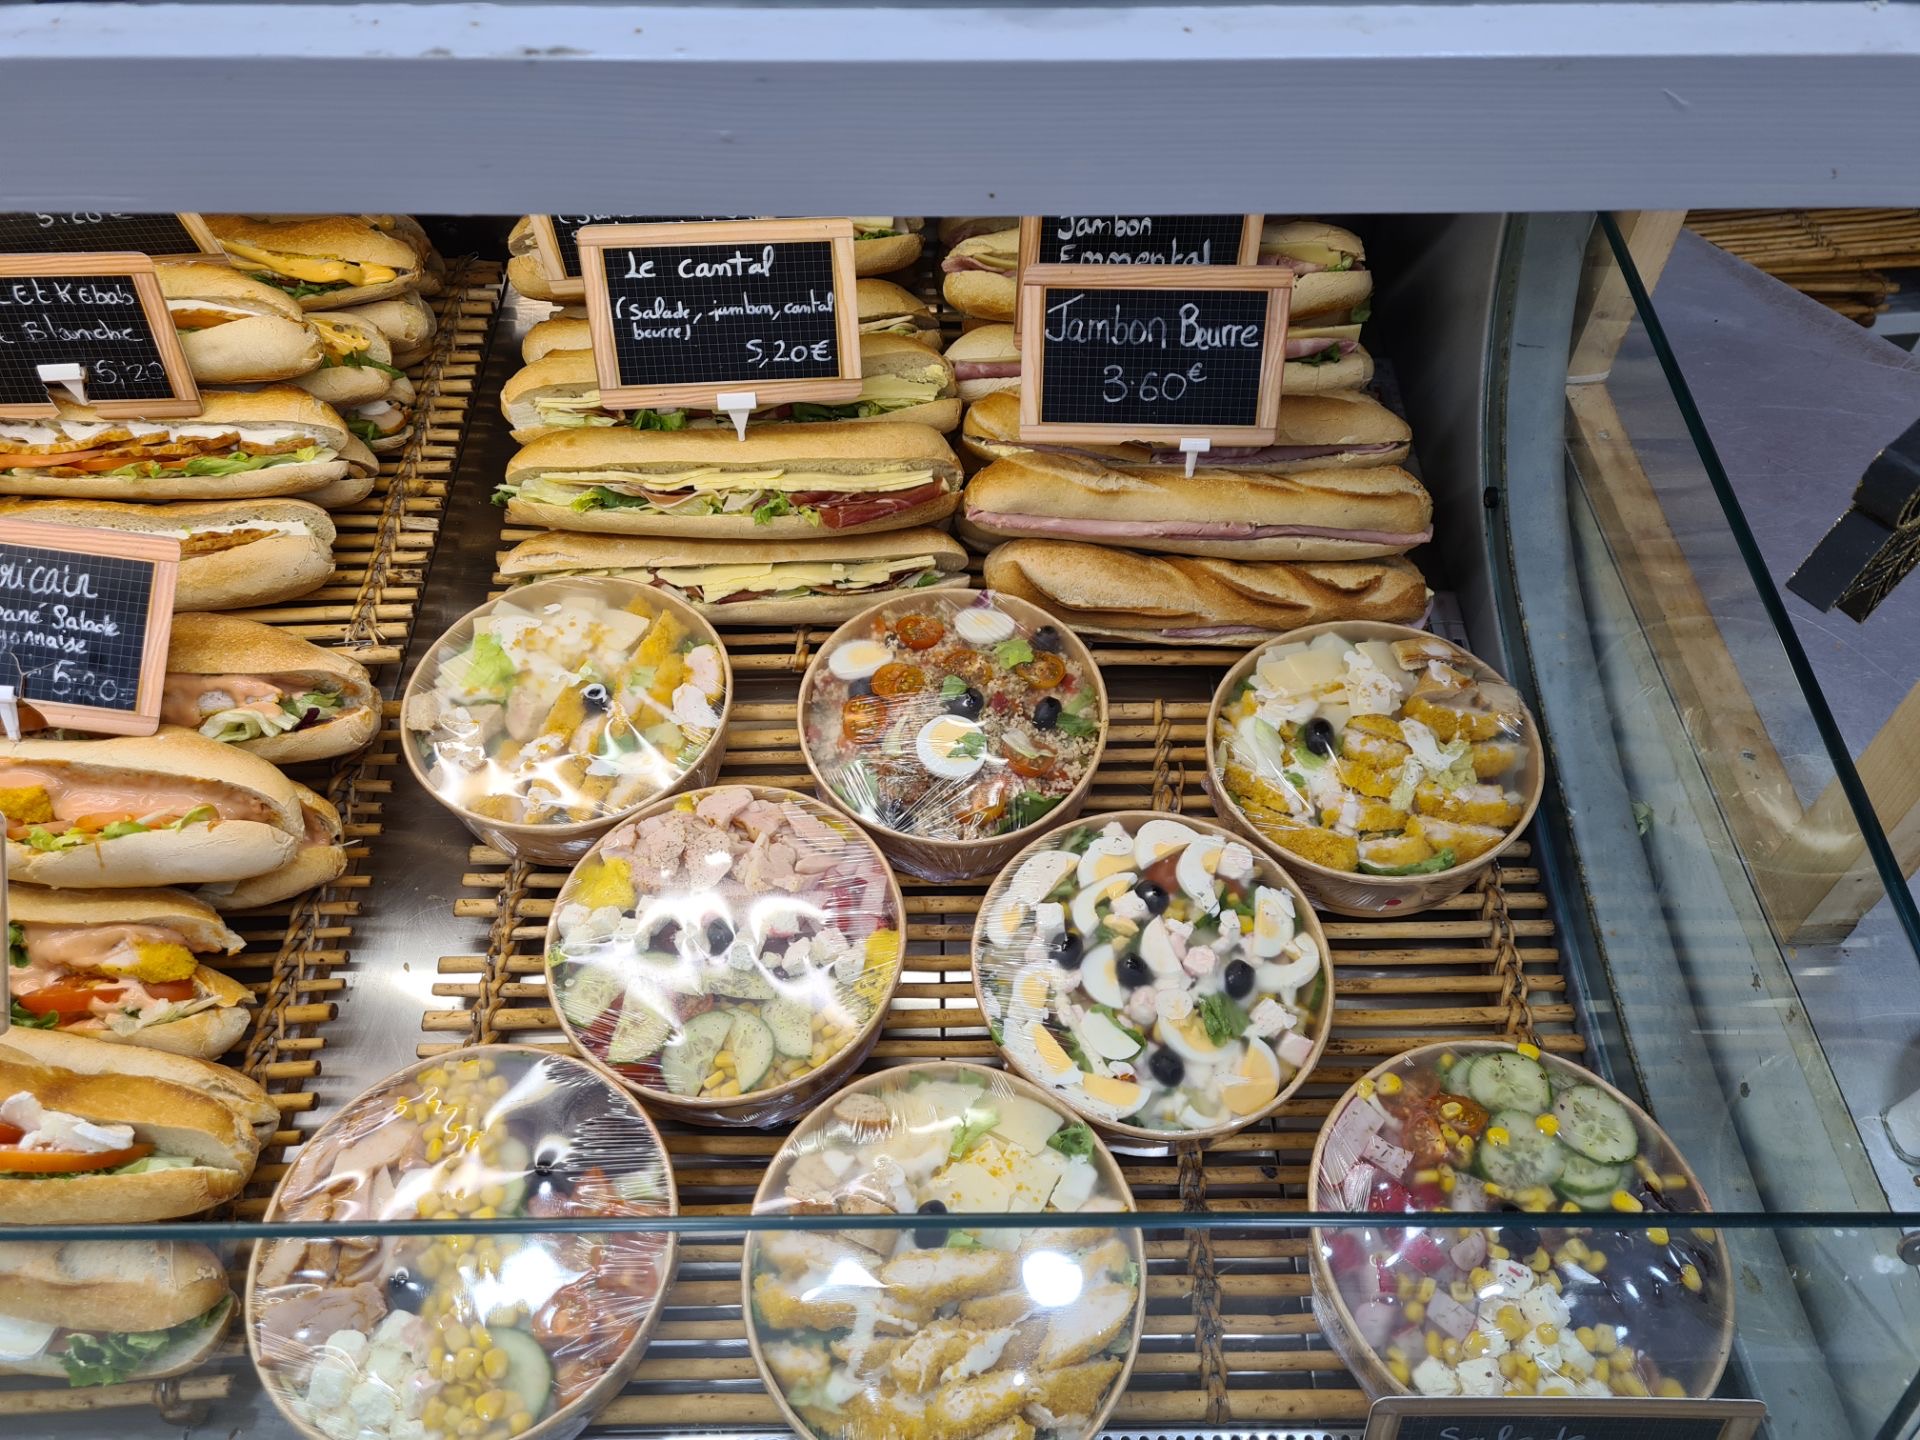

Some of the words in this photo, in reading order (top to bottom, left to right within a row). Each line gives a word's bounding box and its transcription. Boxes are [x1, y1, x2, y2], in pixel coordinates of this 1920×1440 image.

[1057, 216, 1152, 240] Jambon
[624, 251, 657, 279] Le
[783, 288, 834, 314] cantal
[21, 313, 144, 342] Blanche
[632, 322, 691, 341] beurre)
[1045, 293, 1167, 349] Jambon
[1179, 303, 1259, 350] Beurre
[745, 338, 832, 368] 5,20€
[0, 552, 98, 598] ricain
[52, 604, 120, 637] Salade
